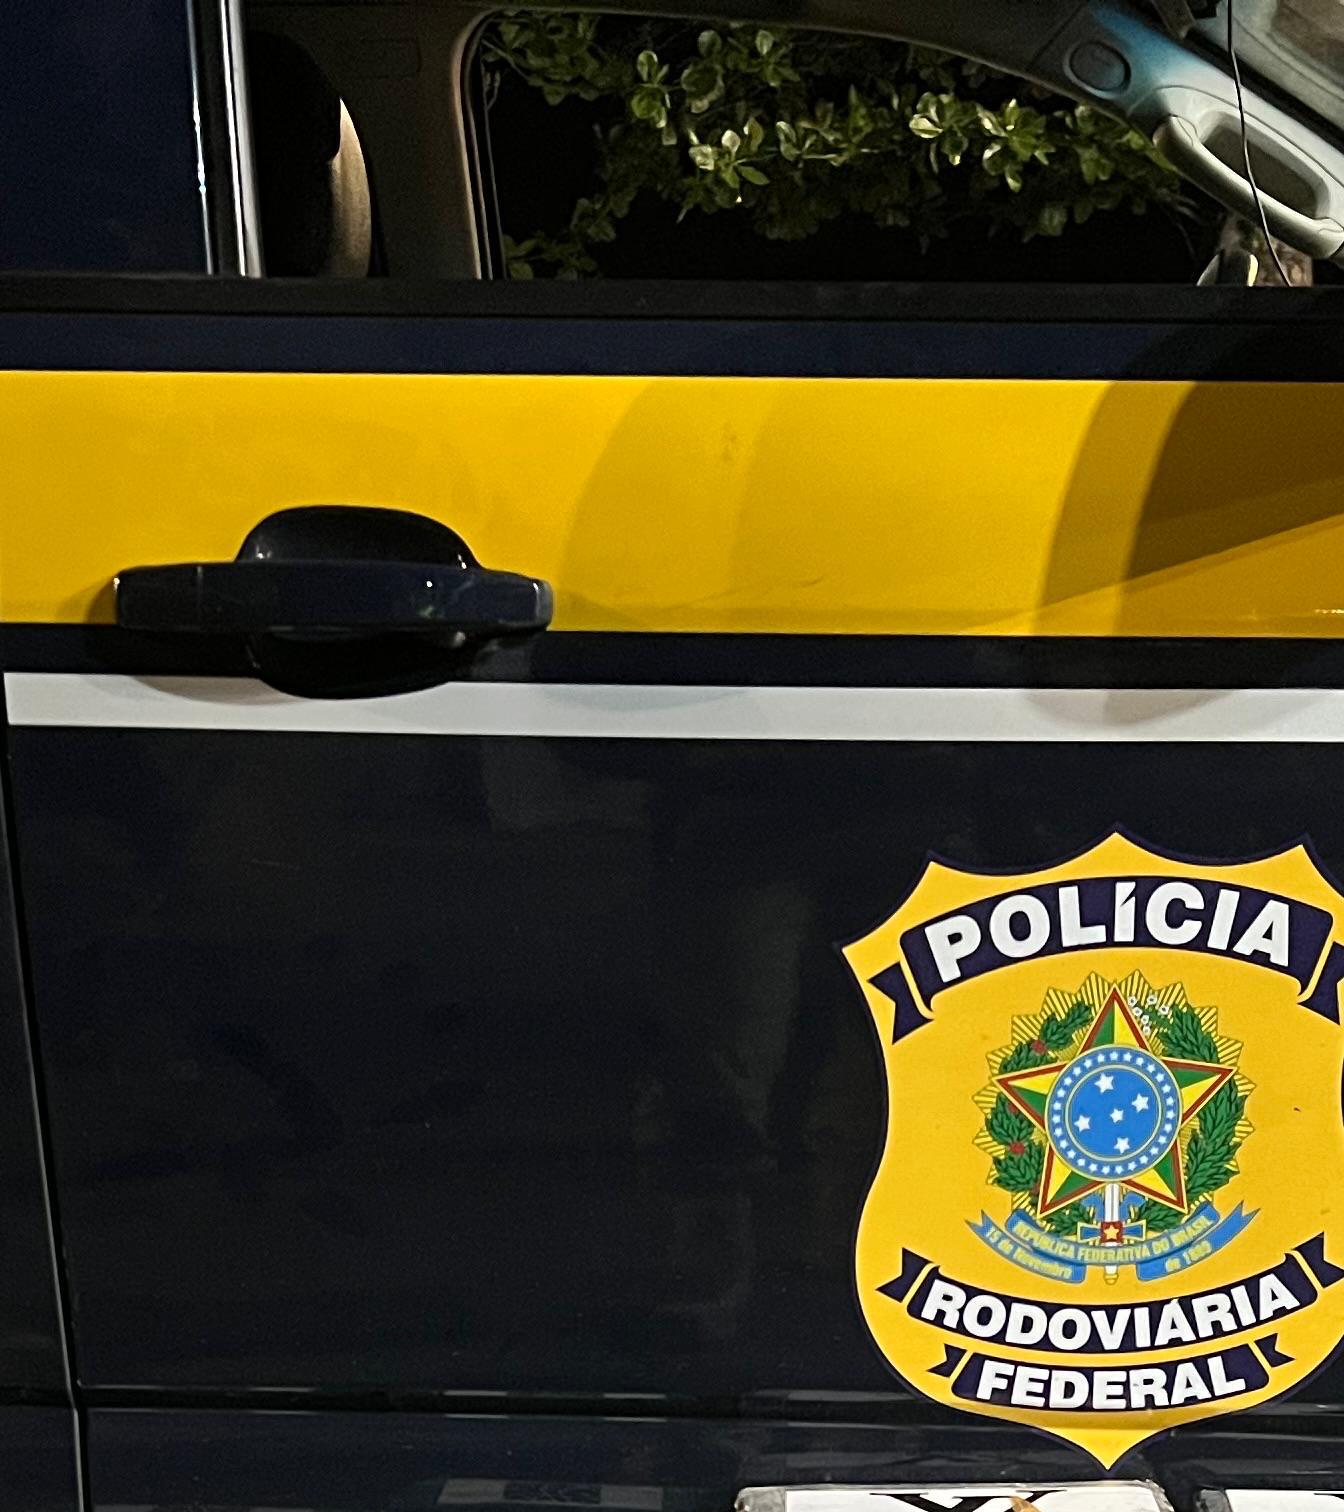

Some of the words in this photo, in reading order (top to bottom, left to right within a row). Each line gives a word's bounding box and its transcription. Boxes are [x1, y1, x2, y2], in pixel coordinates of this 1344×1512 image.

[923, 880, 1292, 983] POLÍCIA
[920, 1273, 1301, 1352] RODOVIÁRIA
[975, 1356, 1247, 1411] FEDERAL
